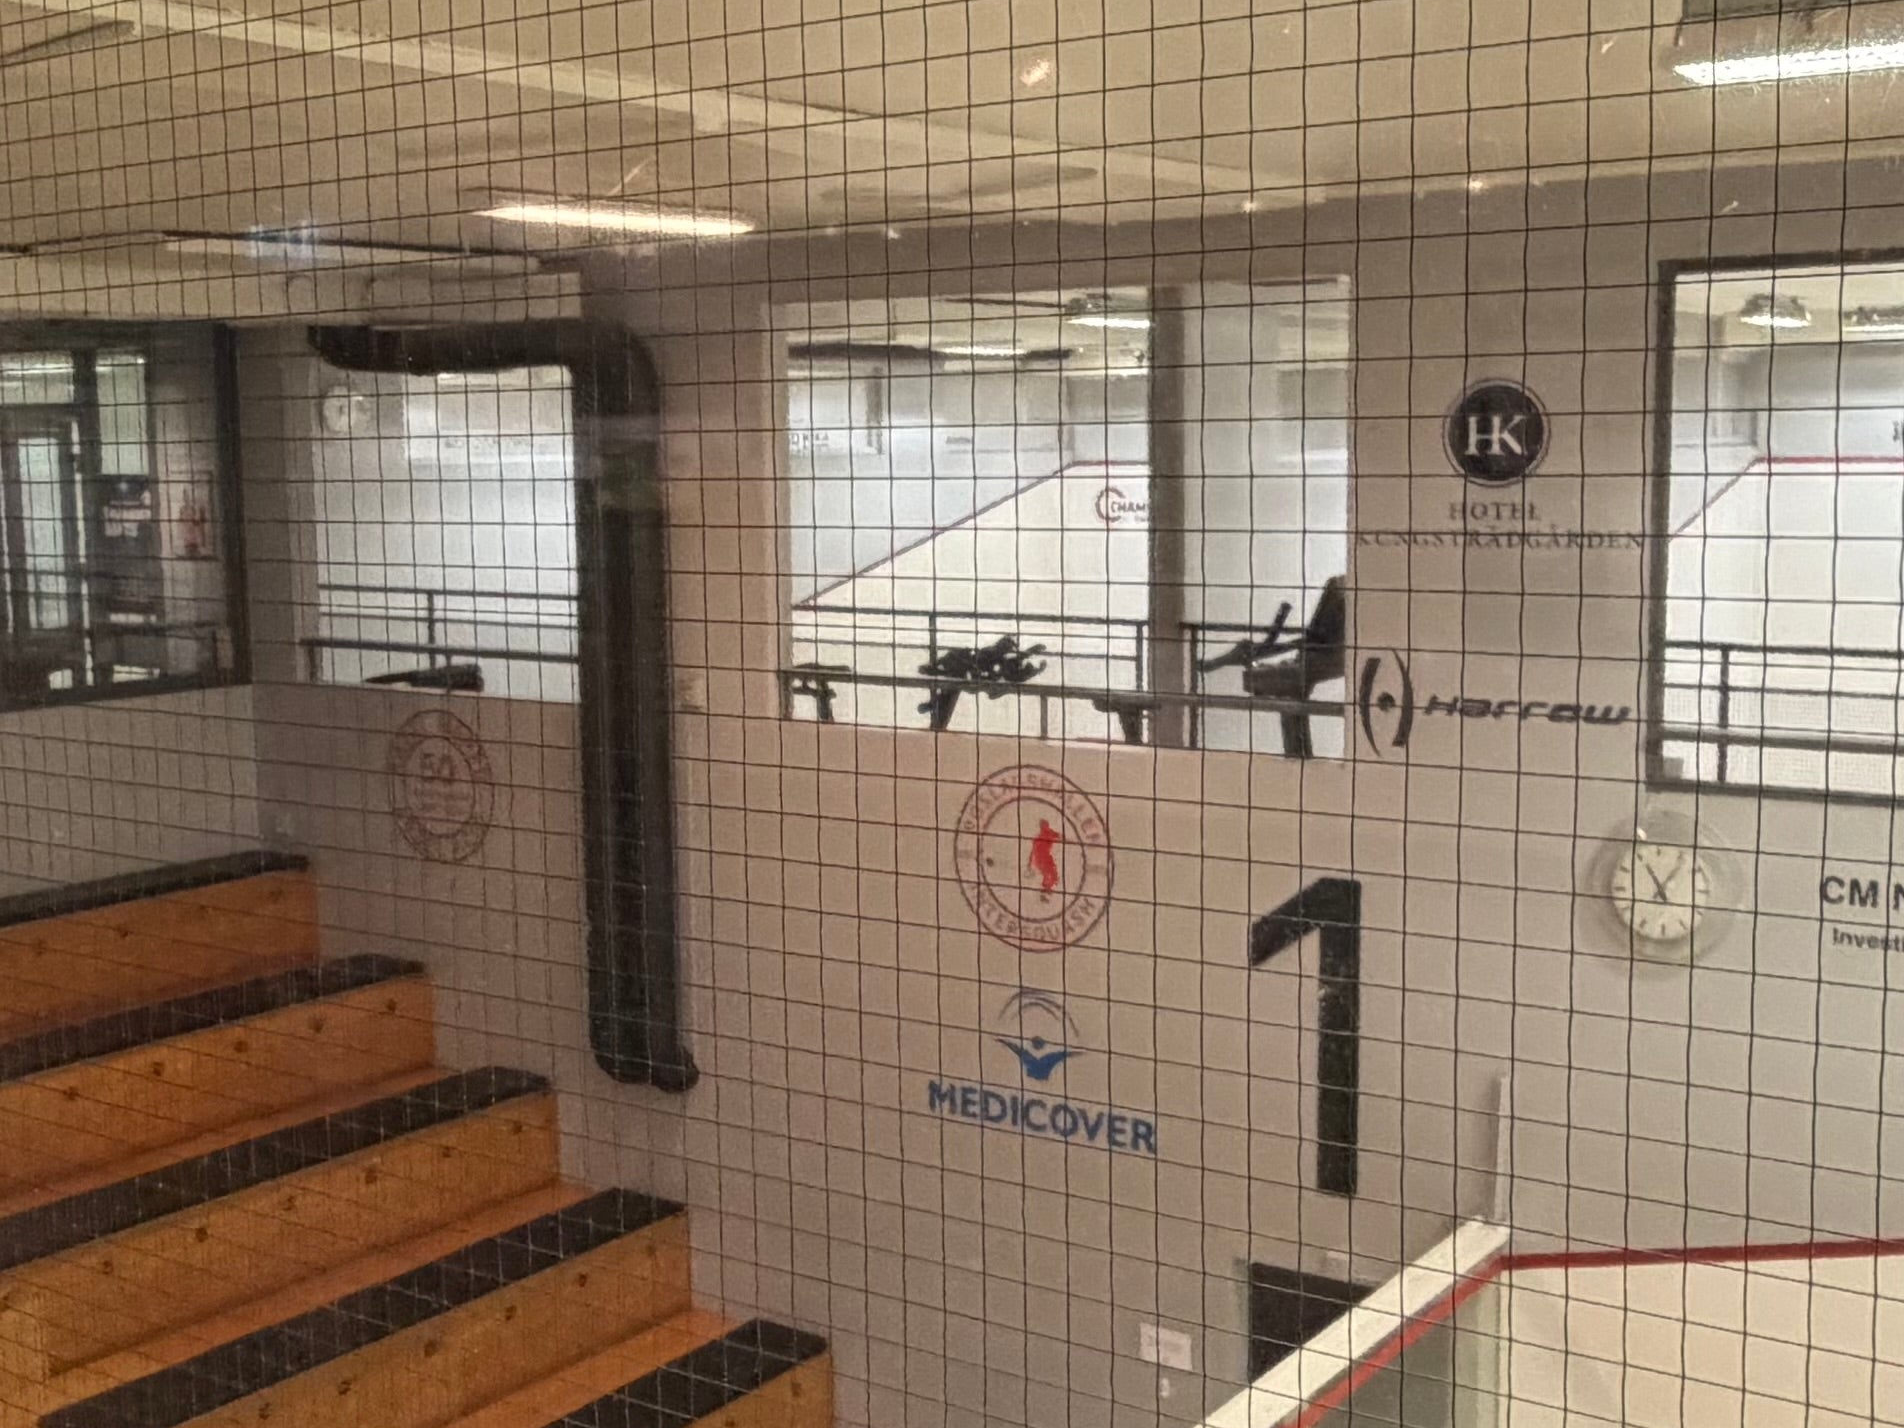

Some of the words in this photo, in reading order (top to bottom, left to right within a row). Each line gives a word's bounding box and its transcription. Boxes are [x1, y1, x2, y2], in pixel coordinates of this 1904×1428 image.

[1464, 414, 1527, 457] HK
[1449, 501, 1543, 522] HOTEL
[1821, 875, 1880, 909] CM
[1248, 876, 1362, 1196] 1
[927, 1079, 1158, 1156] MEDICOVER
